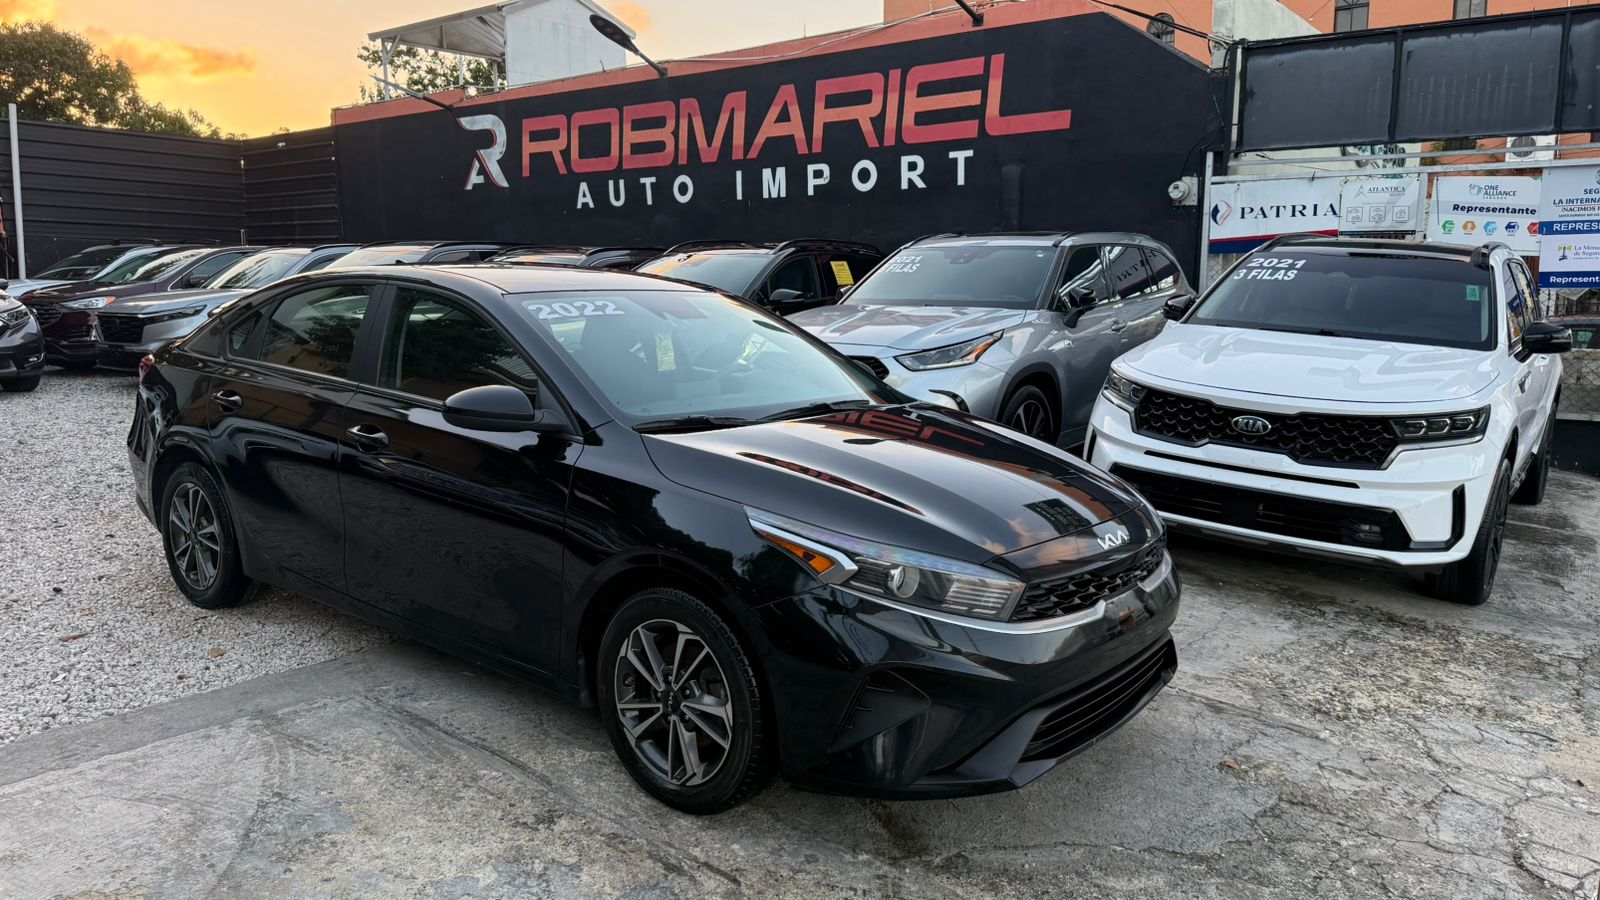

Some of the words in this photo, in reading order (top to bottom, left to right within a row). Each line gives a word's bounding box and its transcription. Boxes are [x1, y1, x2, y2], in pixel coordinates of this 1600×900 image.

[522, 53, 1072, 177] ROBMARIEL
[576, 175, 694, 209] AUTO
[736, 150, 974, 200] IMPORT
[1239, 202, 1339, 220] PATRIA
[1452, 203, 1537, 216] Representante
[1246, 257, 1307, 269] 2021
[1233, 268, 1247, 280] 3
[1246, 269, 1298, 281] FILAS
[527, 300, 625, 320] 2022
[1236, 417, 1265, 433] KIA
